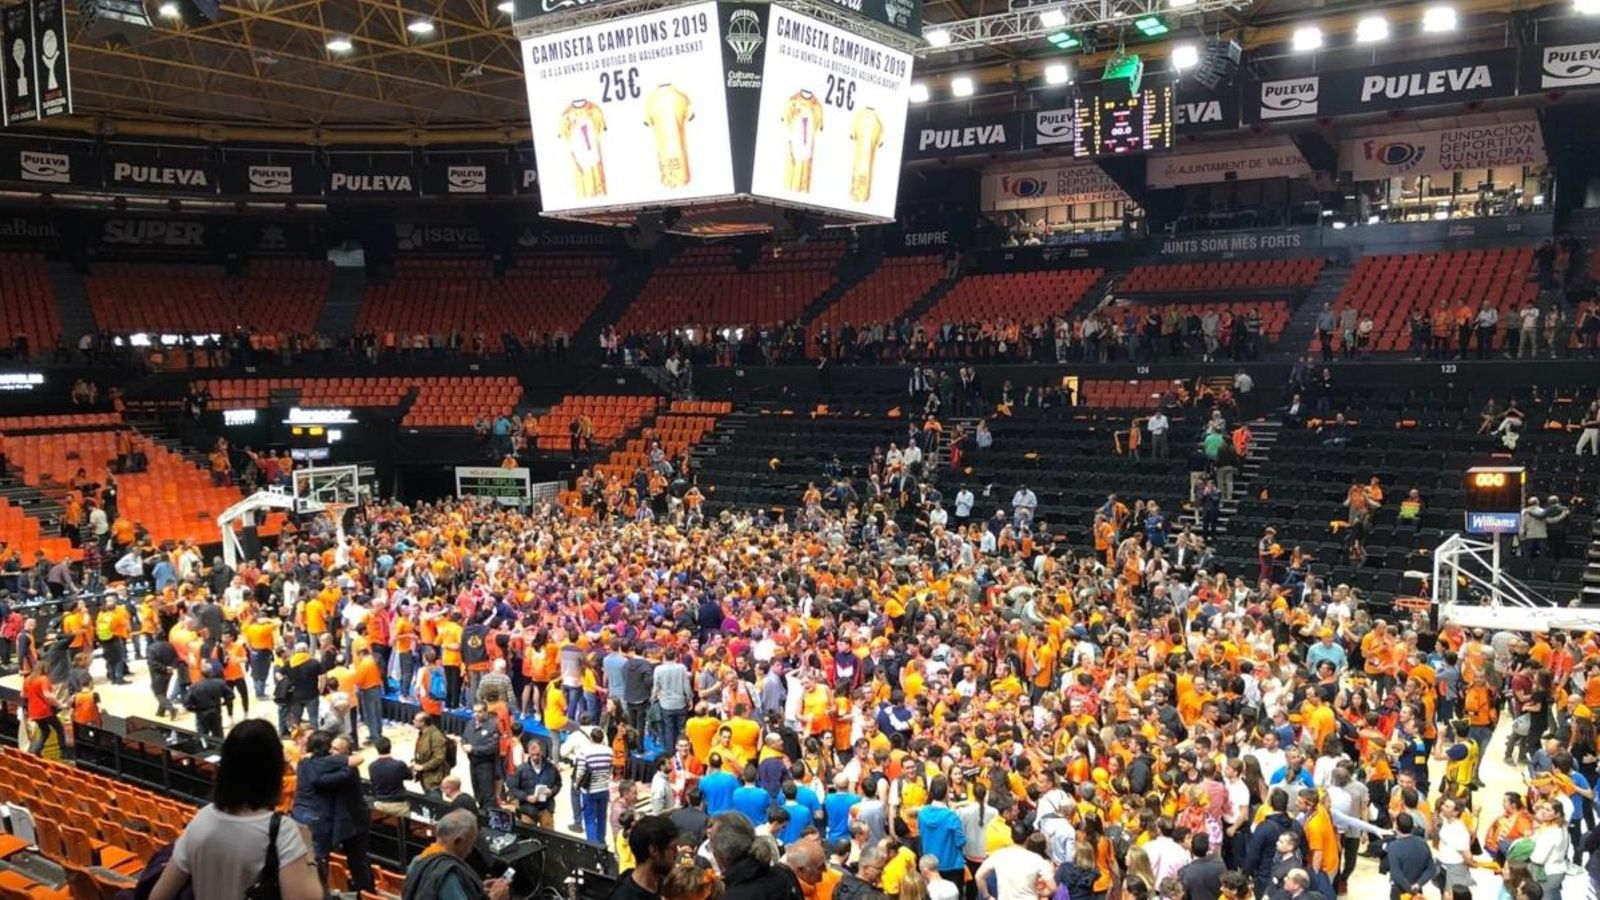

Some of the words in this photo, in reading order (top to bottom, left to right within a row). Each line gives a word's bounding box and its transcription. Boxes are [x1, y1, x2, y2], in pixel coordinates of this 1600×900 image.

[532, 35, 594, 64] CAMISETA
[599, 20, 667, 52] CAMPIONS
[672, 12, 708, 38] 2019
[639, 48, 673, 62] VALENCIA
[675, 40, 703, 55] BASKET
[778, 17, 828, 52] CAMISETA
[833, 35, 881, 69] CAMPIONS
[885, 55, 906, 77] 2019
[1547, 49, 1600, 64] PULEV
[728, 70, 755, 79] Cultura
[600, 67, 641, 103] 25€
[728, 79, 761, 88] Esfuerzo
[1264, 83, 1315, 98] PULEVA
[1361, 65, 1492, 102] PULEVA
[825, 74, 857, 111] 25€
[1039, 113, 1073, 126] PULEV
[919, 125, 1006, 151] PULEVA
[1441, 135, 1536, 153] DEPORTIVA
[23, 154, 66, 167] PULEVA
[1440, 144, 1534, 163] MUNICIPAL
[1178, 159, 1247, 174] AJUNTAMENT
[1249, 159, 1261, 169] DE
[1441, 156, 1536, 171] VALENCIA
[114, 162, 208, 186] PULEVA
[251, 168, 290, 180] PULEVA
[331, 172, 413, 192] PULEVA
[450, 168, 483, 179] PULEVA
[103, 219, 206, 245] SUPER
[905, 231, 948, 247] SEMPRE
[1161, 240, 1198, 254] JUNTS
[1200, 238, 1228, 252] SOM
[1260, 234, 1301, 249] FORTS
[1441, 364, 1457, 374] 123
[1472, 514, 1516, 528] Williams
